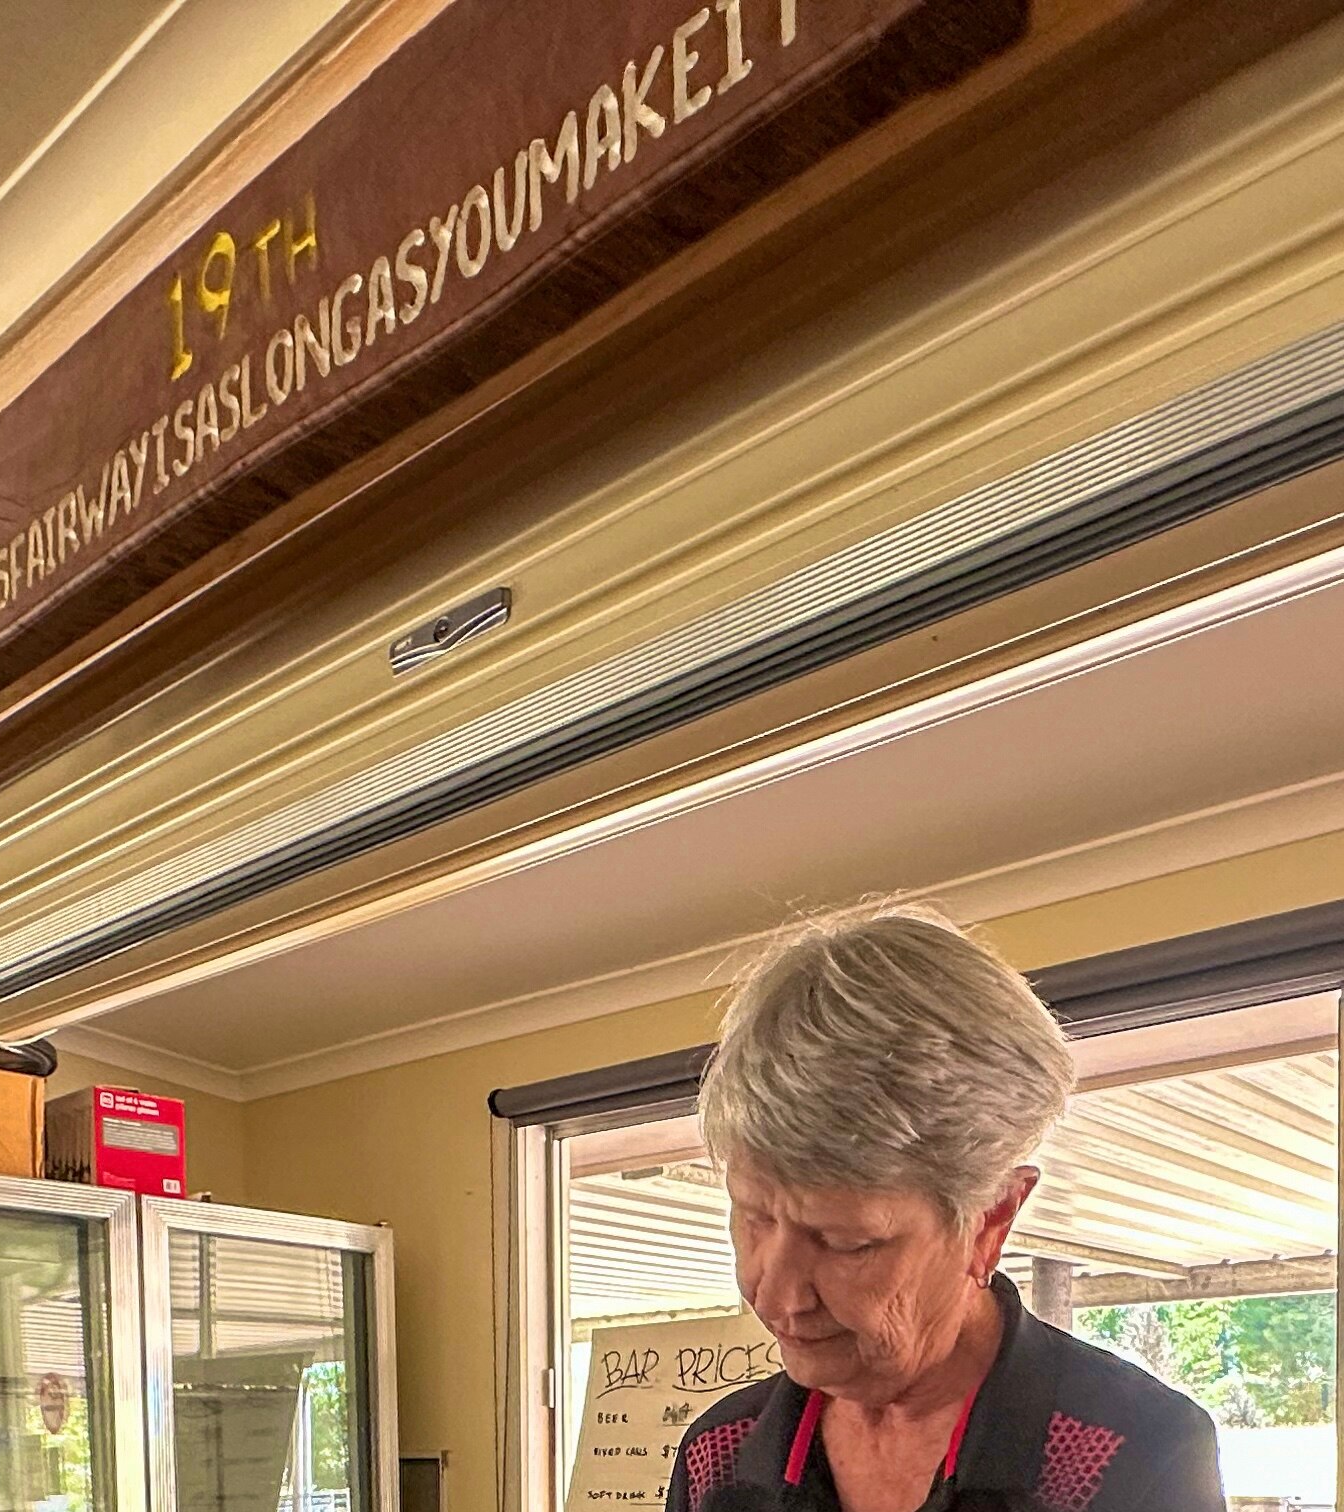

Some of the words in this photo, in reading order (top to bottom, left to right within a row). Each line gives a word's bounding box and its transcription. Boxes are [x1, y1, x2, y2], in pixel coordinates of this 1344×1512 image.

[169, 188, 316, 381] 19TH
[602, 1348, 660, 1388] BAR
[597, 1412, 629, 1424] BEER
[587, 1490, 613, 1500] SOFT
